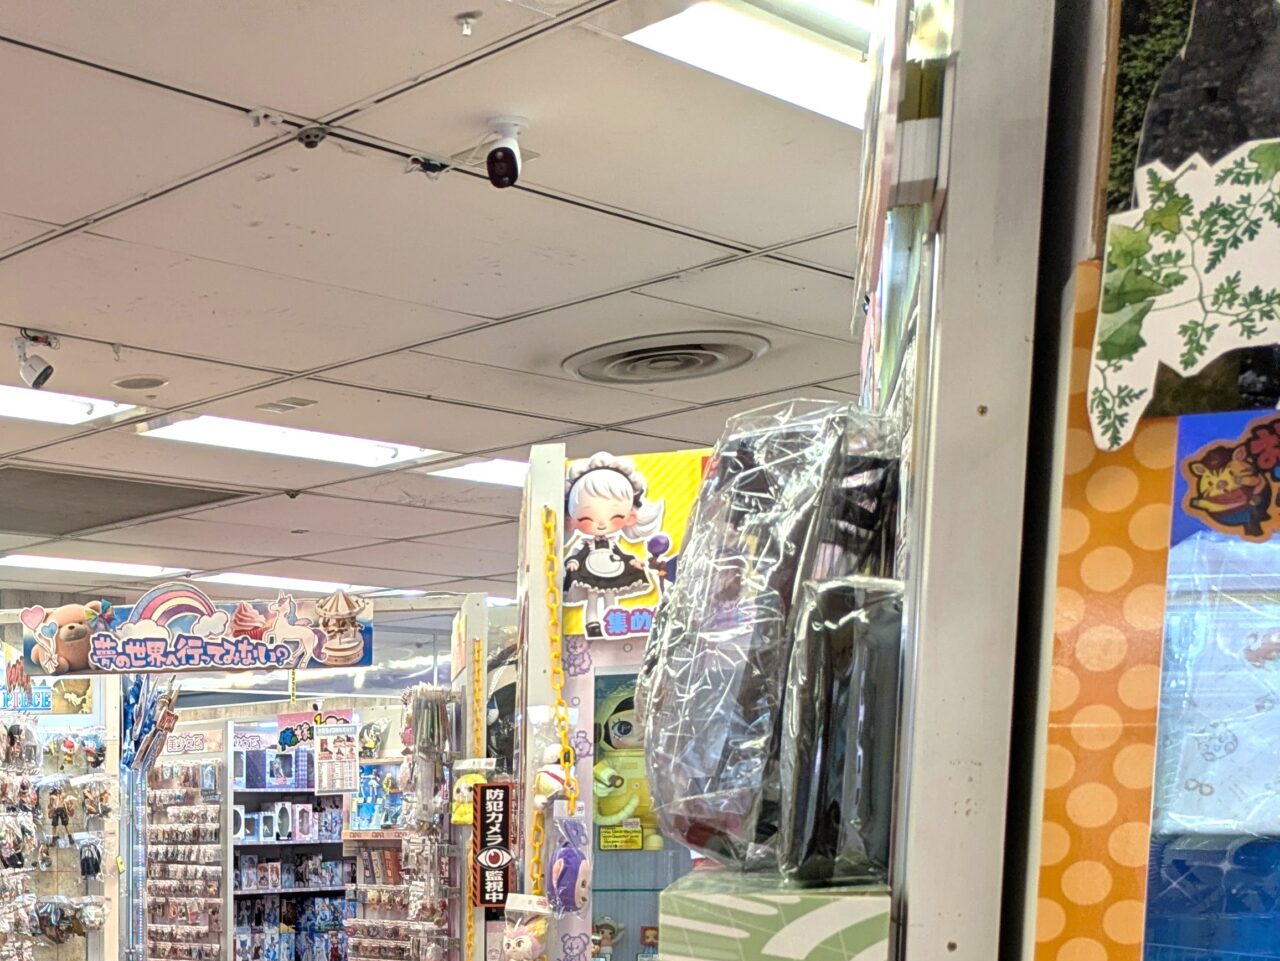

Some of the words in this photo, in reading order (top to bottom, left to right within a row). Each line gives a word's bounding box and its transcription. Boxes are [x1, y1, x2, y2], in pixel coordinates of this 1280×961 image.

[91, 634, 292, 669] 夢の世界へ行ってみない?
[485, 788, 505, 845] 防犯カメラ
[484, 870, 504, 903] 監視中
